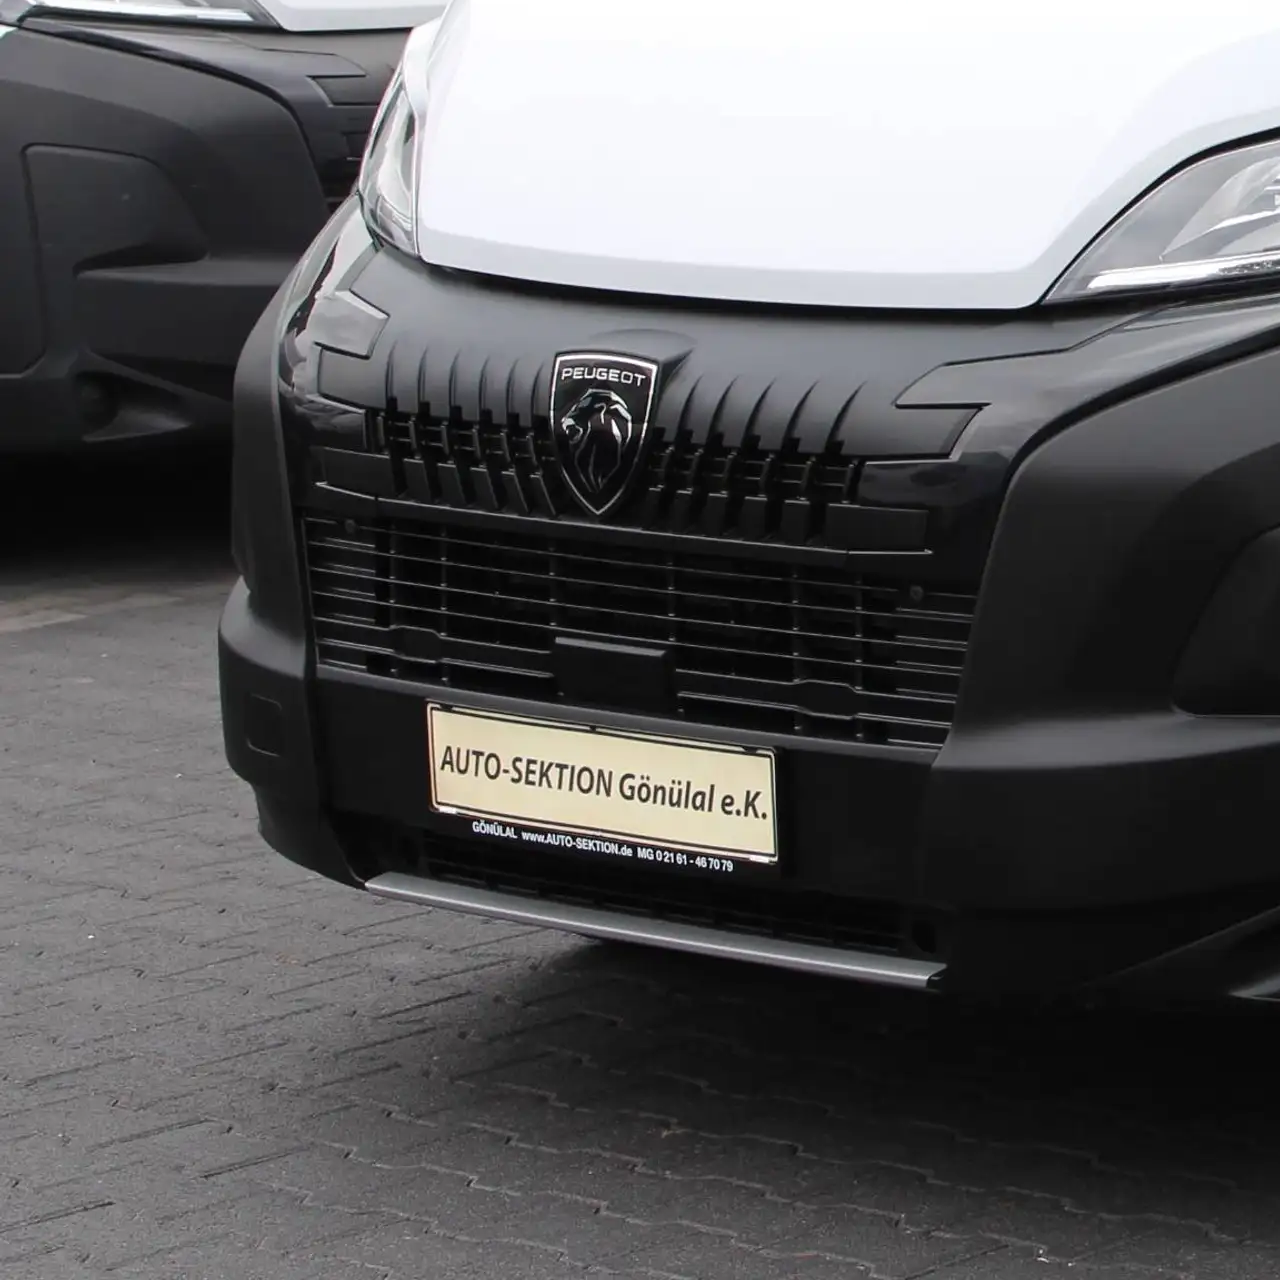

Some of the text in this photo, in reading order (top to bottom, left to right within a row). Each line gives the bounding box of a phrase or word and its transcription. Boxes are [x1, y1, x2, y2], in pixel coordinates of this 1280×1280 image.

[561, 367, 646, 387] PEUGEOT
[440, 745, 768, 820] AUTO-SEKTION Gönülal e.K.
[472, 820, 518, 839] GÖNÜLAL
[521, 831, 633, 857] www.AUTO-SEKTION.de
[637, 846, 654, 860] MG
